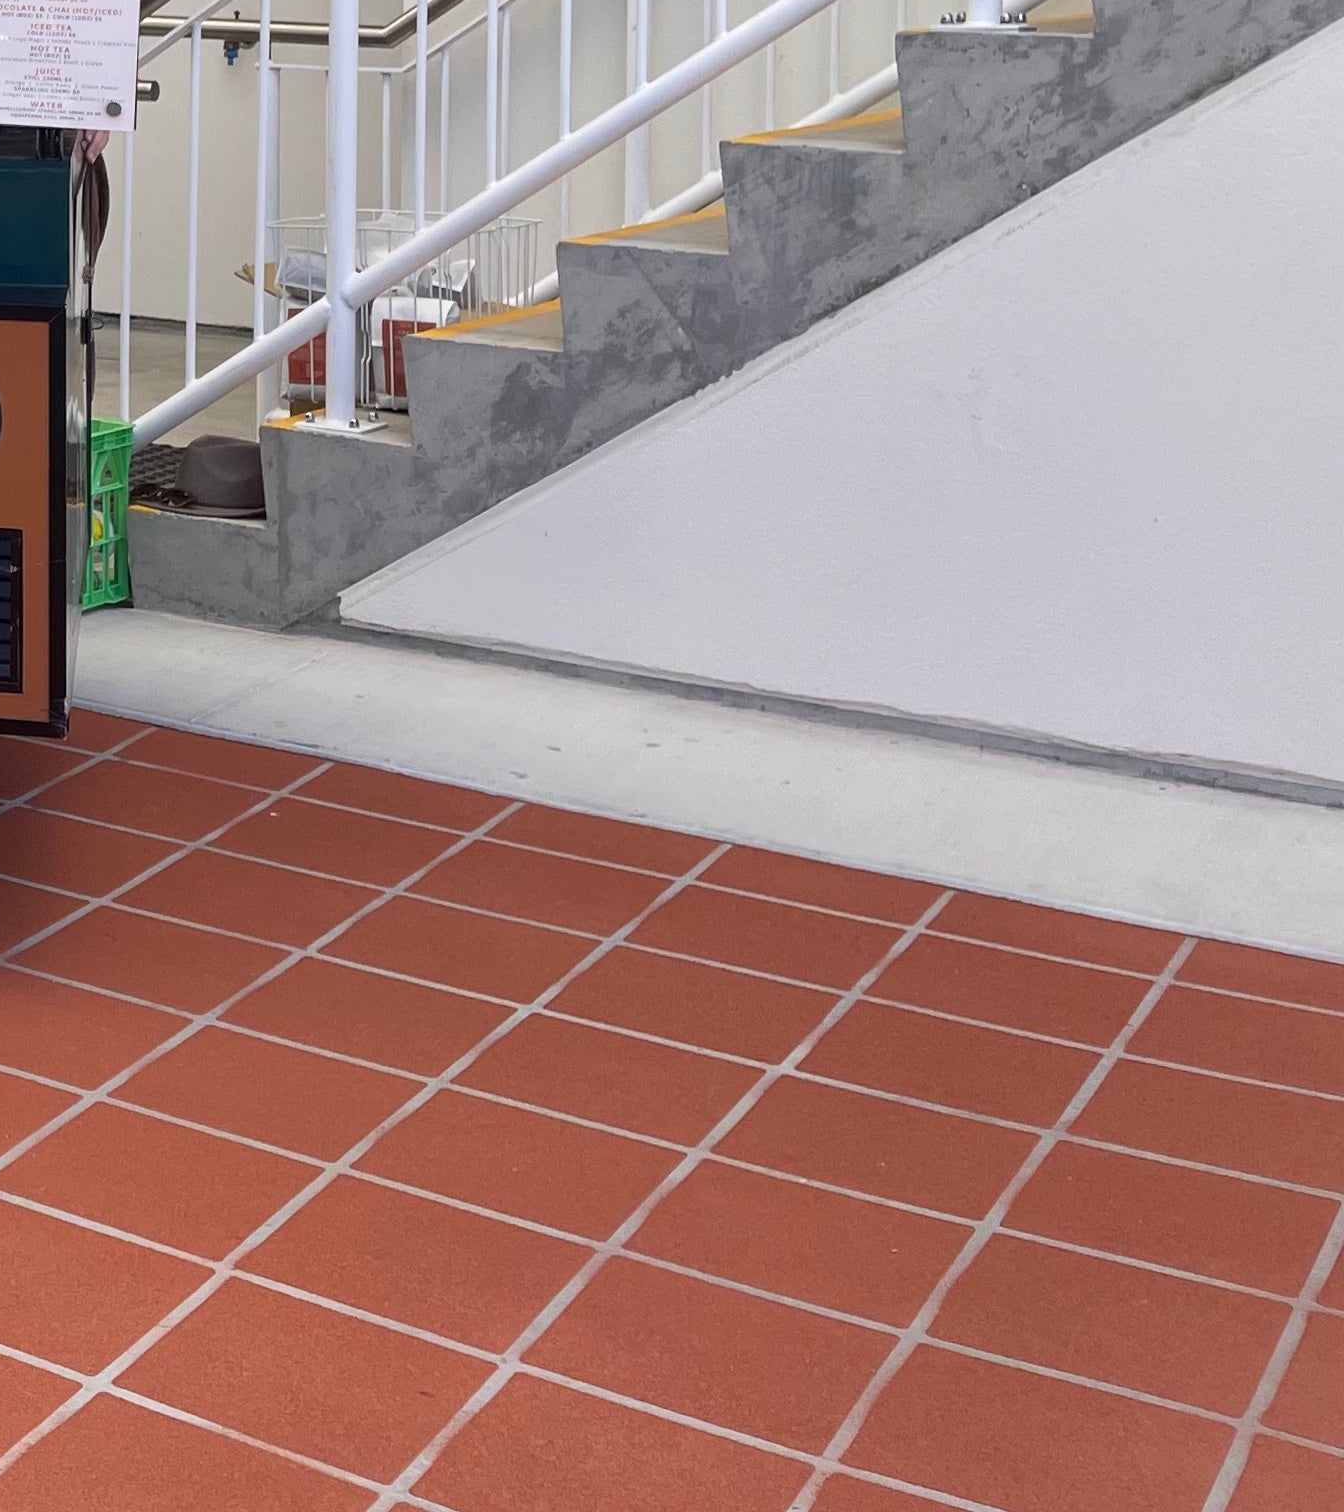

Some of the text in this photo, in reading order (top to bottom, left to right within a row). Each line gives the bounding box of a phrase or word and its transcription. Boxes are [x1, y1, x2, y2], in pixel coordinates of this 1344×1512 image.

[48, 6, 70, 14] CHAI
[30, 45, 50, 53] HOT
[35, 68, 61, 76] JUICE
[30, 101, 63, 109] WATER
